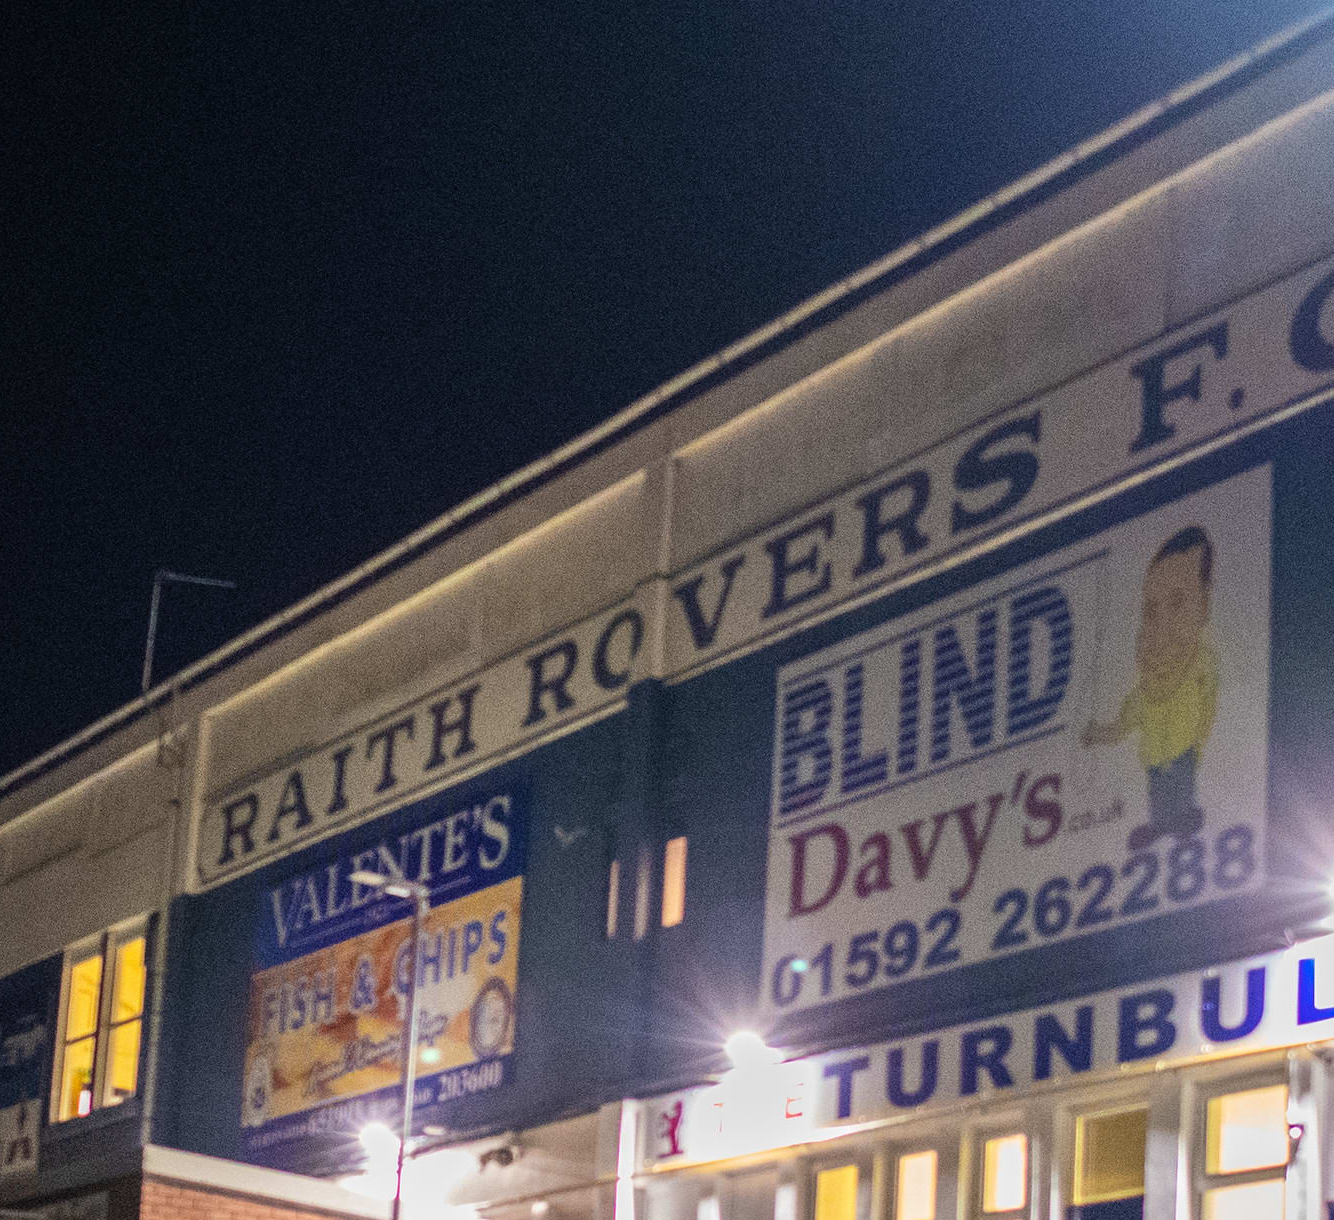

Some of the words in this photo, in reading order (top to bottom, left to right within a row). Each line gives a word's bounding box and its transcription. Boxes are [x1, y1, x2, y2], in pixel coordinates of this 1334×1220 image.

[219, 684, 480, 865] RAITH
[522, 410, 1042, 727] ROVERS
[779, 585, 1074, 816] BLIND
[272, 795, 511, 947] VALENTE'S
[772, 908, 962, 1008] 01592
[992, 825, 1256, 950] 262288
[787, 770, 1064, 919] Davy's
[266, 967, 335, 1034] FISH
[348, 955, 379, 1014] &
[394, 907, 509, 999] CHIPS
